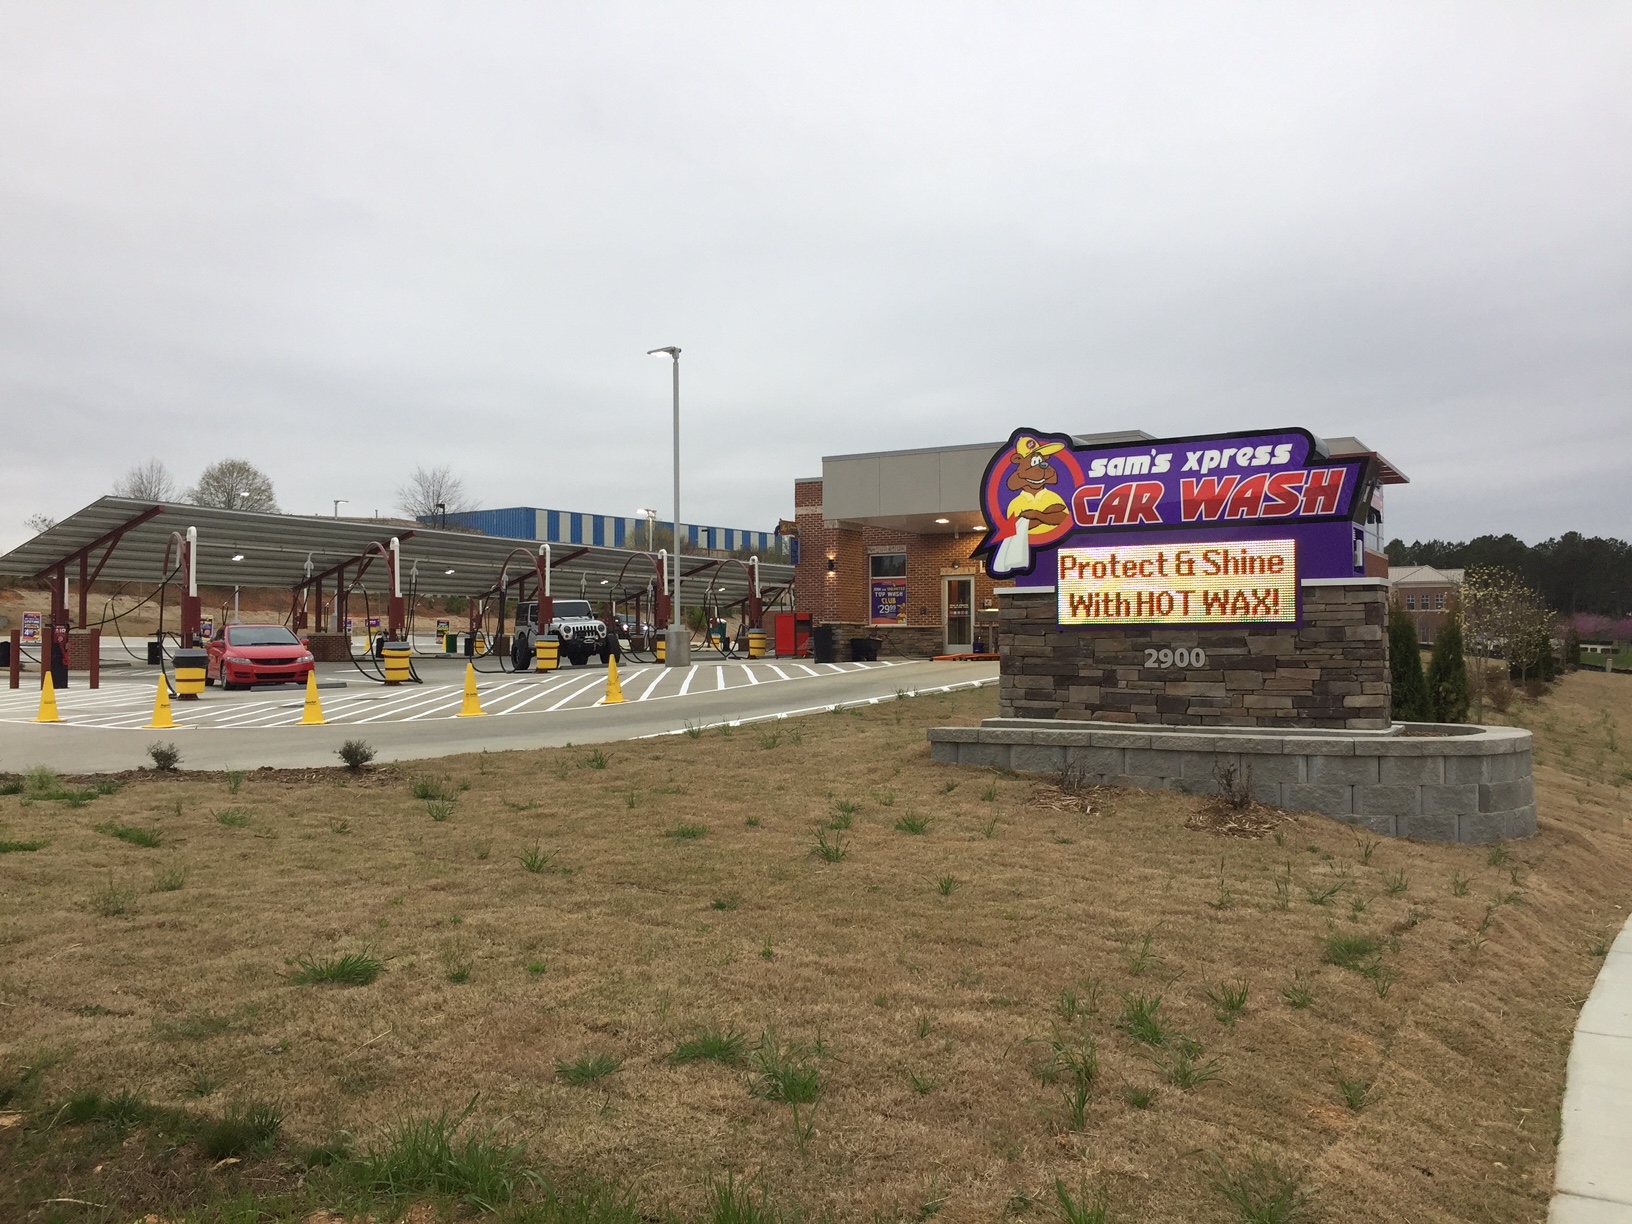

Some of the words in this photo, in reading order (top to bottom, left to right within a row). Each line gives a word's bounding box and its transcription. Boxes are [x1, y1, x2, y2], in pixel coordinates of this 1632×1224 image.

[1088, 448, 1173, 477] sam's
[1181, 443, 1293, 474] xpress
[1071, 481, 1165, 527] CAR
[1180, 467, 1348, 522] WASH
[1059, 551, 1168, 580] Protect
[1175, 550, 1196, 576] &
[1202, 548, 1284, 576] Shine
[1069, 591, 1131, 618] With
[1136, 590, 1196, 617] HOT
[1202, 587, 1280, 616] WAX!
[1144, 647, 1206, 668] 2900
